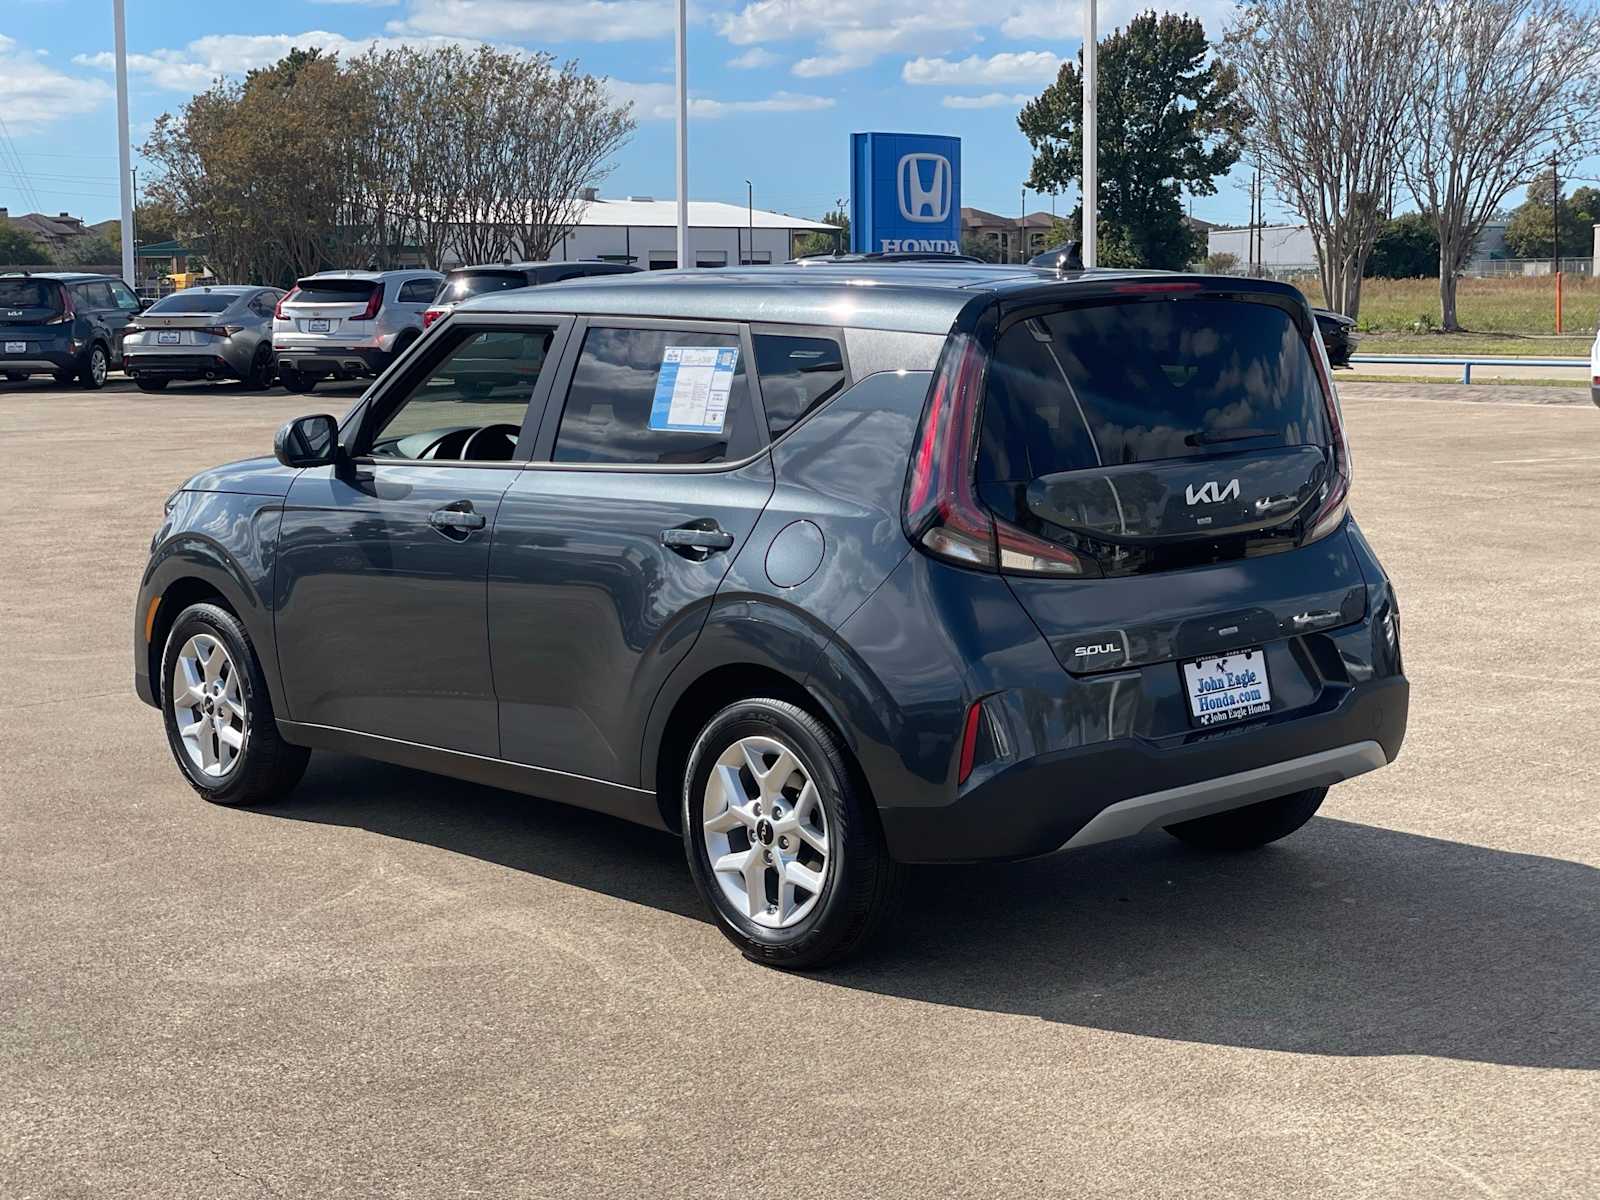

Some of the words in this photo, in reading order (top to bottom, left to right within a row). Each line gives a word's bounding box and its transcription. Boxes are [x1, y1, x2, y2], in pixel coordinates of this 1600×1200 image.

[880, 239, 961, 256] HONDA
[1185, 478, 1241, 506] KIA
[1074, 643, 1121, 657] SOUL
[1197, 676, 1225, 693] John
[1225, 669, 1257, 688] Eagle
[1198, 688, 1262, 712] Honda.com
[1209, 711, 1228, 724] John
[1227, 706, 1248, 719] Eagle
[1247, 702, 1271, 715] Honda
